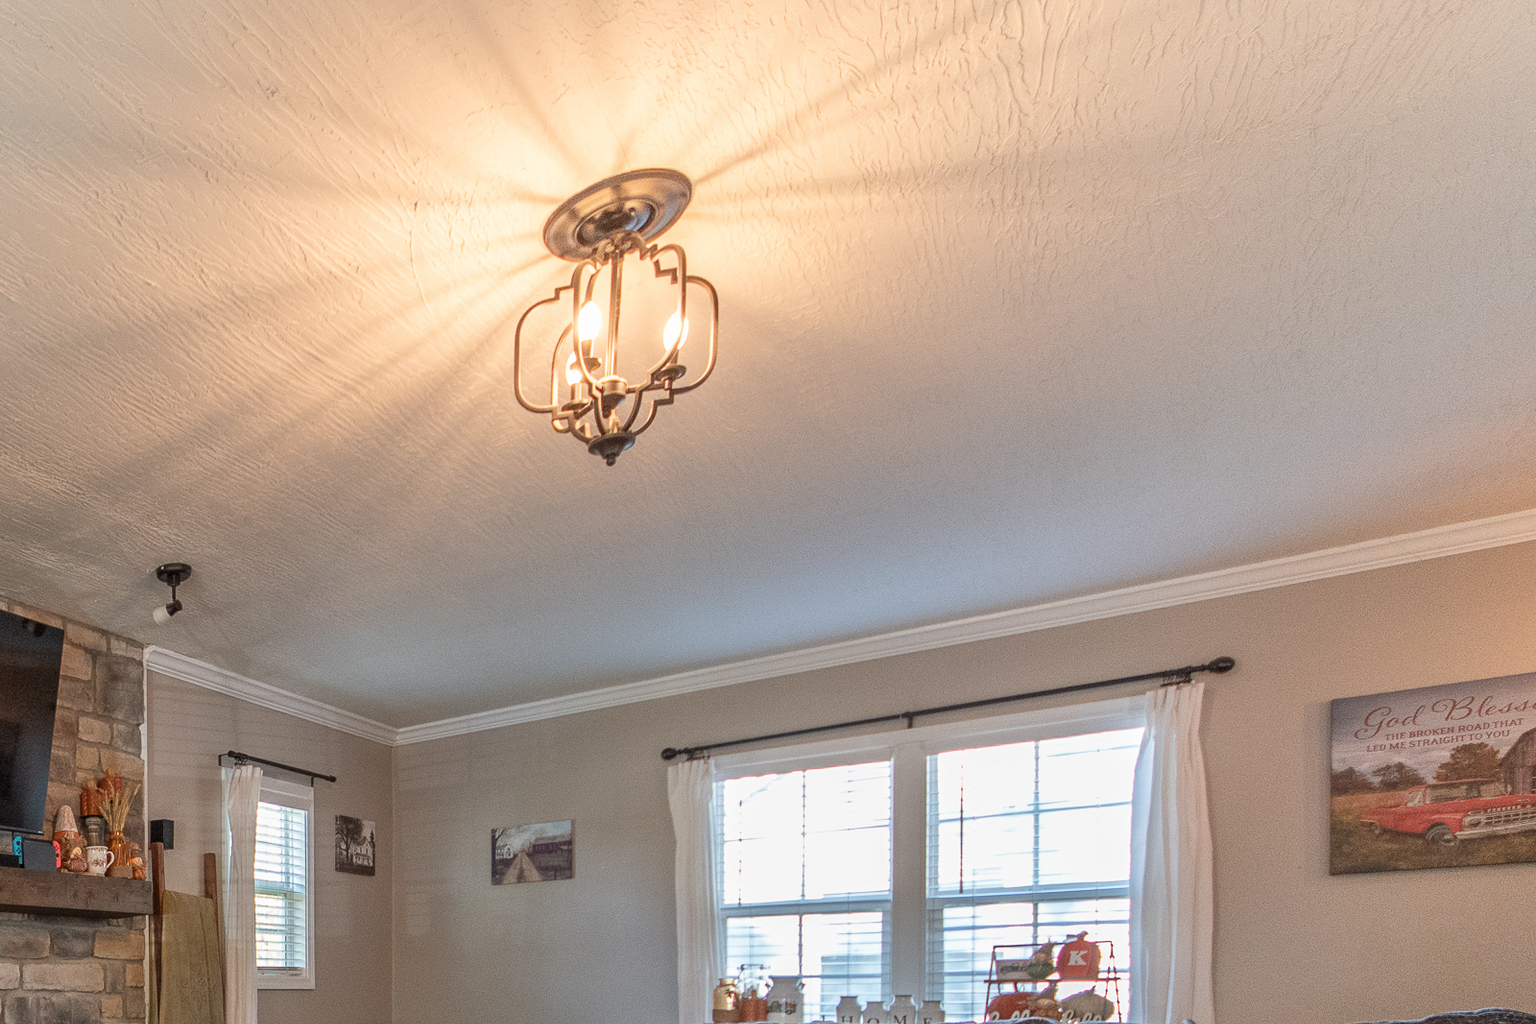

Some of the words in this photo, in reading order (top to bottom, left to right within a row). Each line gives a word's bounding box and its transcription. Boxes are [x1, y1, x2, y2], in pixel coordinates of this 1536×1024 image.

[1354, 705, 1425, 740] God
[1385, 732, 1406, 741] THE
[1409, 726, 1455, 738] BROKEN
[1458, 721, 1490, 733] ROAD
[1492, 717, 1524, 729] THAT
[1366, 744, 1386, 753] LED
[1389, 741, 1406, 750] ME
[1409, 734, 1467, 748] STRAIGHT
[1468, 732, 1483, 741] TO
[1485, 729, 1511, 739] YOU
[1067, 950, 1088, 966] K
